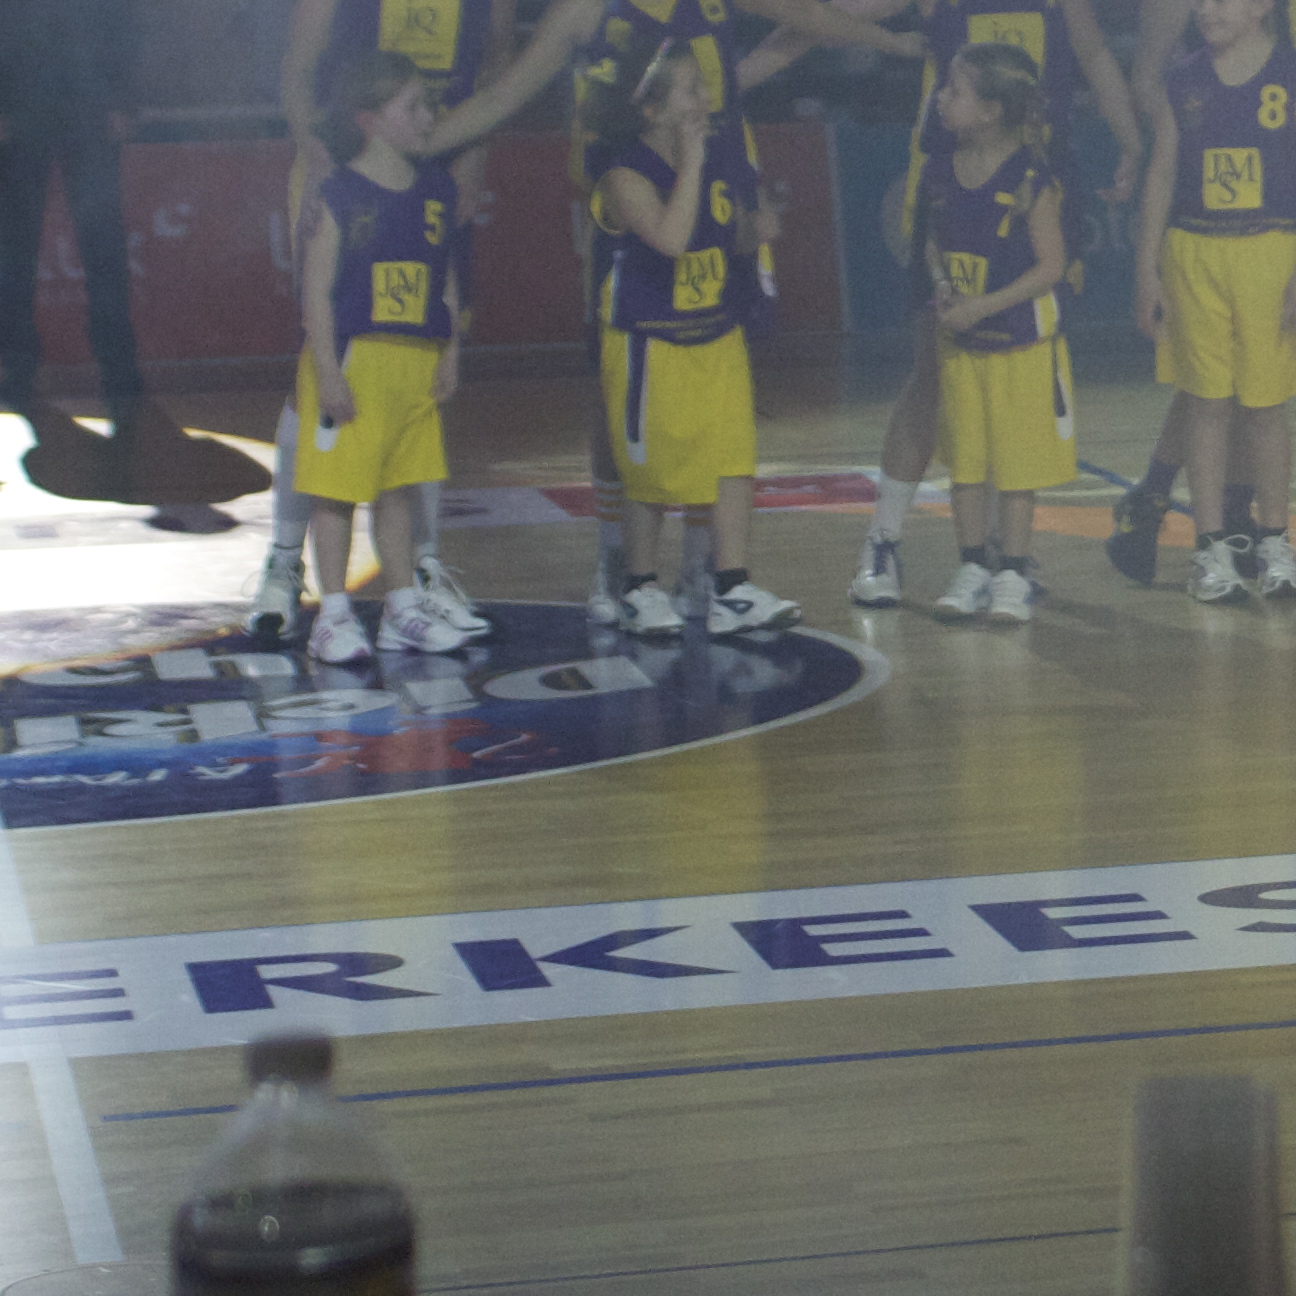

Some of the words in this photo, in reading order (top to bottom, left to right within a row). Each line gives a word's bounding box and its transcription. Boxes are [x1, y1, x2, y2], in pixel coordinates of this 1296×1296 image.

[1257, 83, 1288, 130] 8
[424, 198, 446, 246] 5
[710, 179, 733, 226] 6
